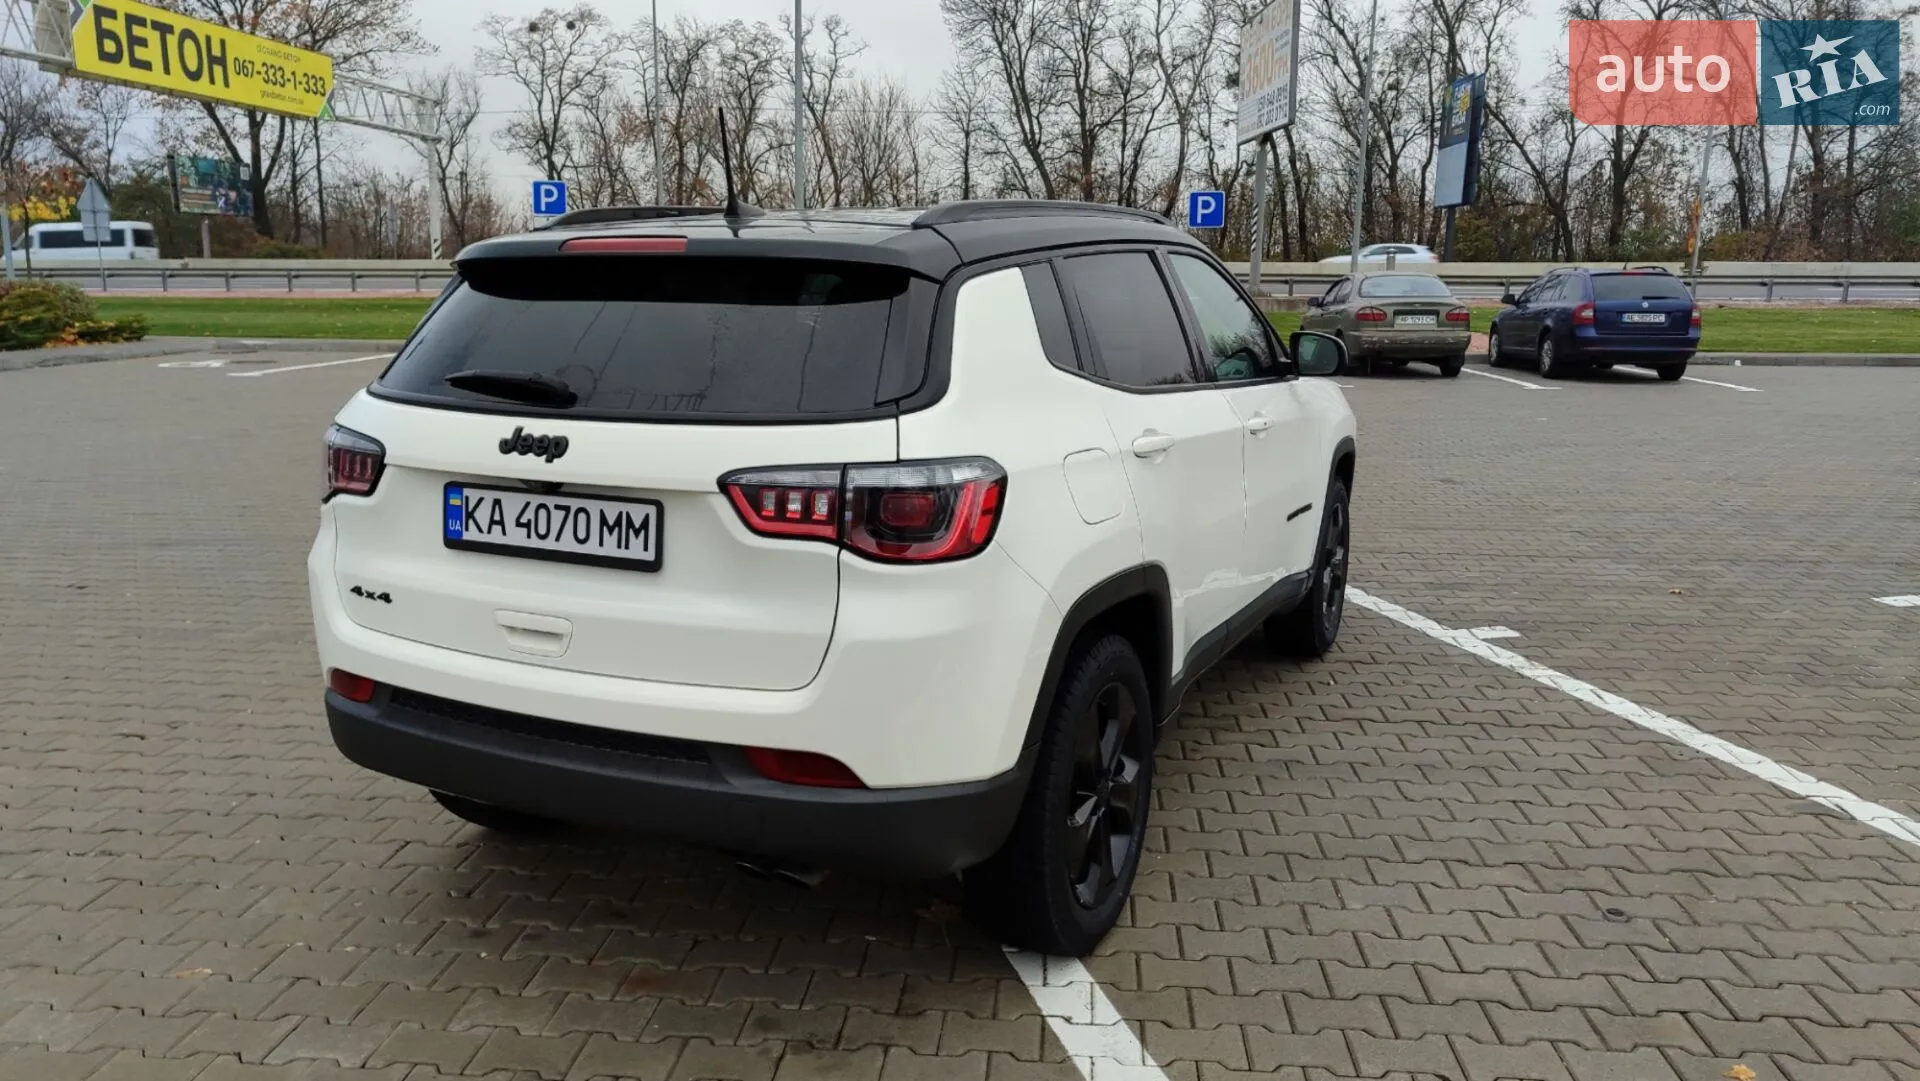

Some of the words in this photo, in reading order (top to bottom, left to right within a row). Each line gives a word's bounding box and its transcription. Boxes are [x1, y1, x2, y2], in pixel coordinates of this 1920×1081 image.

[92, 4, 230, 88] БЕТОН
[234, 56, 326, 97] 067-333-1-333
[541, 185, 559, 211] P
[1197, 196, 1216, 223] P
[499, 426, 569, 463] Jeep
[449, 519, 461, 531] UA
[464, 495, 507, 537] KA
[515, 501, 591, 545] 4070
[599, 508, 650, 552] MM
[350, 585, 392, 604] 4x4
